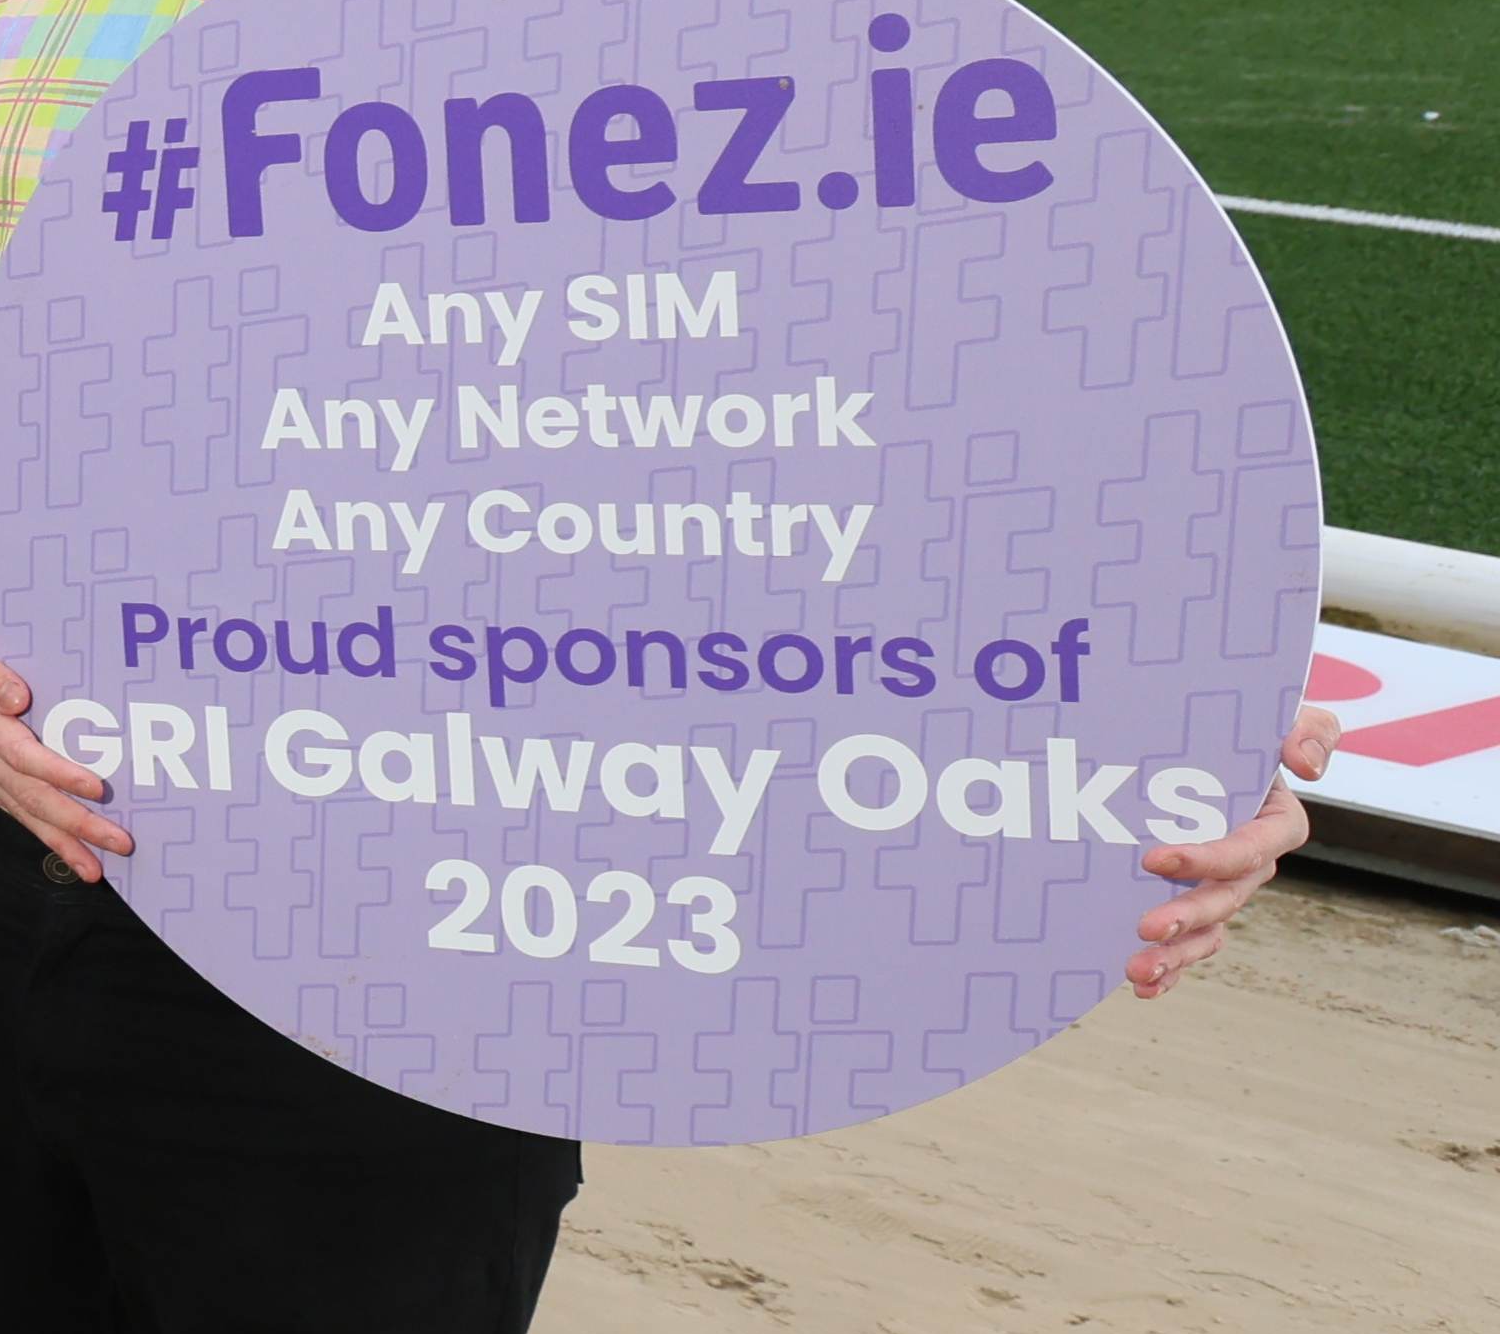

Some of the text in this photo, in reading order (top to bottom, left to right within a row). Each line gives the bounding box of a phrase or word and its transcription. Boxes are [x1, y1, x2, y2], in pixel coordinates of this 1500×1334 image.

[102, 12, 1057, 242] #Fonez.ie
[361, 270, 740, 366] Any SIM
[260, 375, 876, 470] Any Network
[271, 487, 873, 582] Any Country
[120, 602, 1090, 707] Proud sponsors of
[42, 698, 1228, 857] GRI Galway Oaks
[424, 859, 742, 975] 2023
